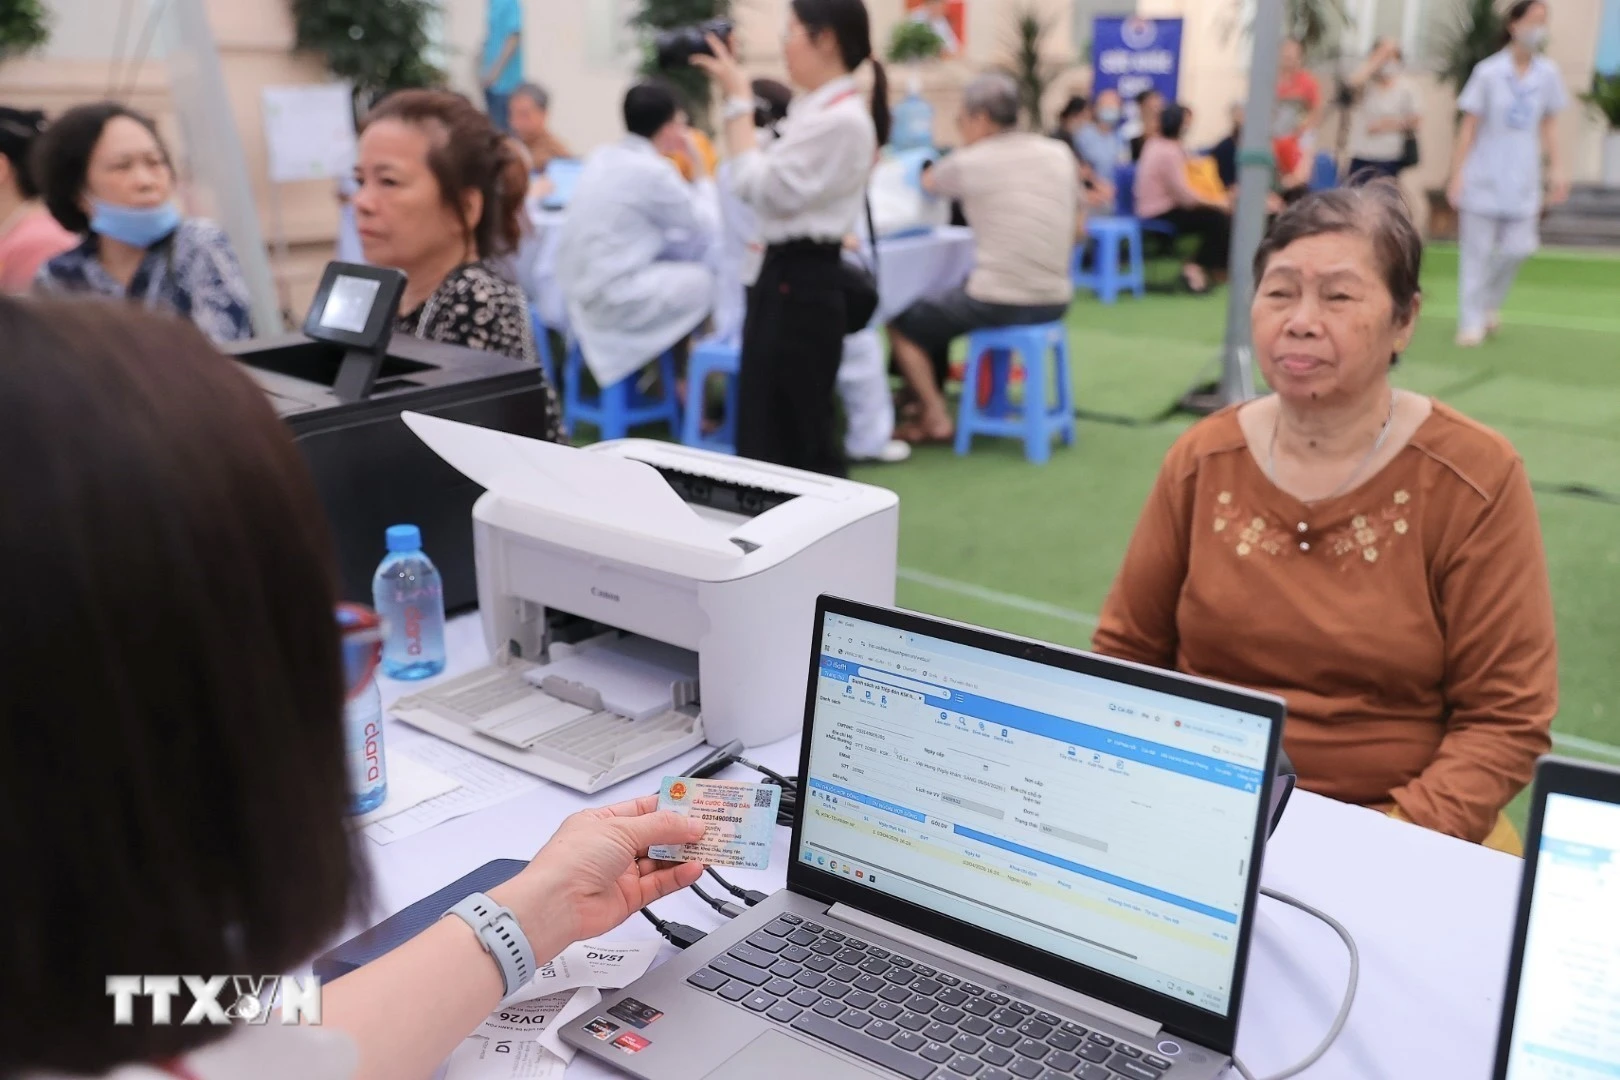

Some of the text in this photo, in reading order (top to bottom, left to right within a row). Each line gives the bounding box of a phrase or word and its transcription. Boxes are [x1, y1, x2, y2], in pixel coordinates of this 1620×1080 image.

[590, 586, 620, 602] Canon
[405, 605, 422, 656] clara
[364, 722, 380, 782] clara
[586, 952, 625, 962] DV51
[500, 1012, 545, 1024] DV26
